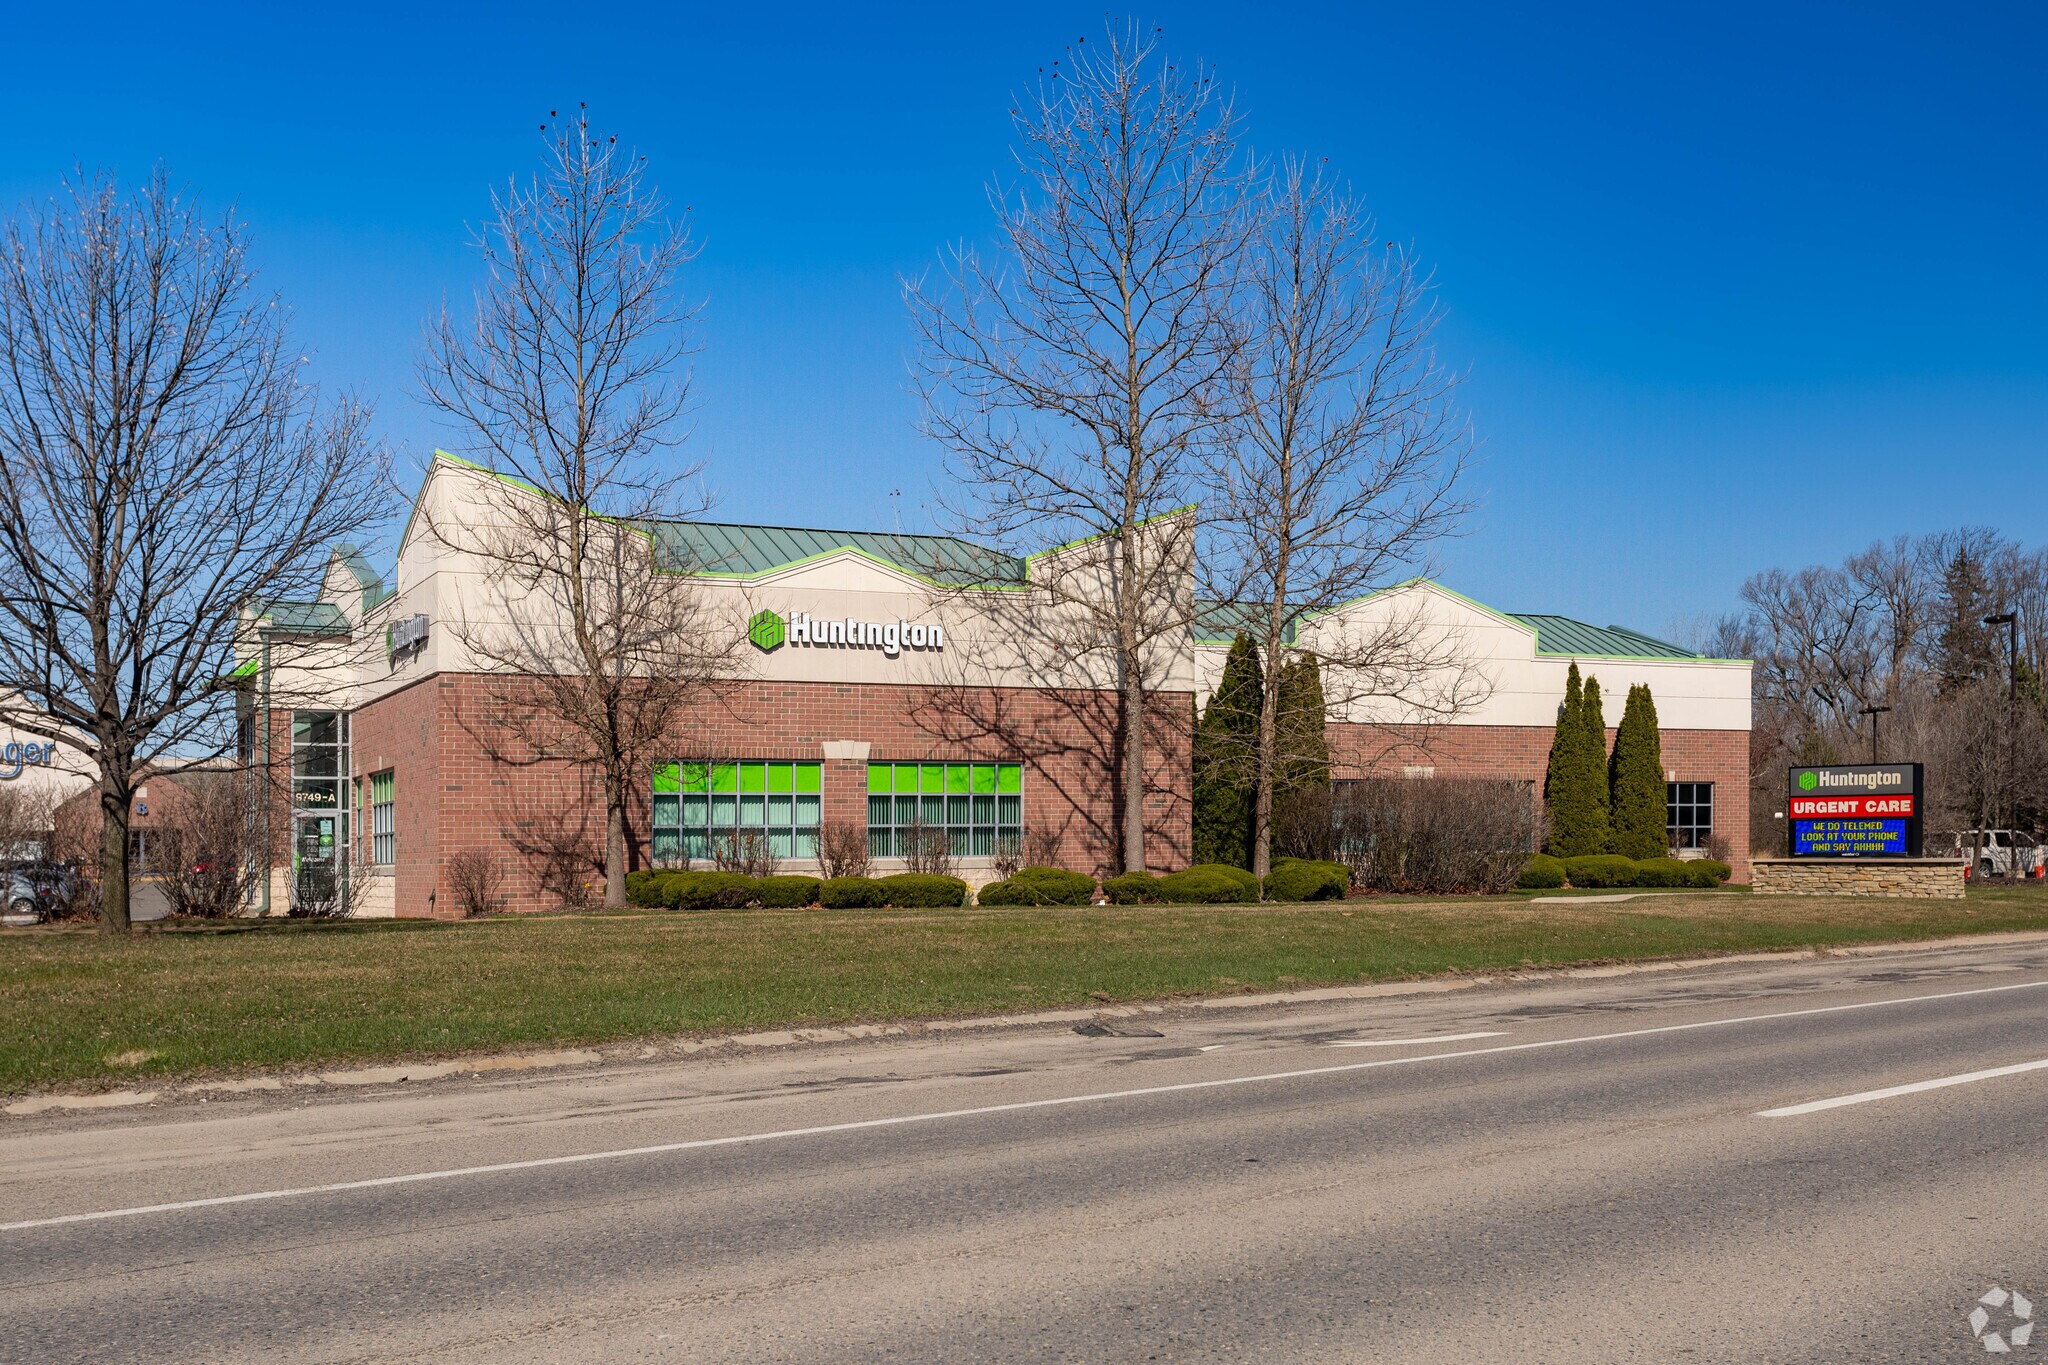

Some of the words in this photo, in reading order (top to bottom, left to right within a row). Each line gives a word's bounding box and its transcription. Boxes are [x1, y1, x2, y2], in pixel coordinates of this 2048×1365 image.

[789, 611, 943, 655] Huntington
[0, 741, 54, 778] ger
[1819, 771, 1901, 790] Huntington
[295, 792, 335, 802] 9749-A
[1794, 801, 1858, 814] URGENT
[1865, 800, 1911, 812] CARE
[1813, 822, 1825, 831] WE
[1828, 822, 1840, 830] DO
[1843, 822, 1883, 830] TELEMED
[1801, 833, 1824, 841] LOOK
[1827, 833, 1839, 841] AT
[1842, 832, 1866, 840] YOUR
[1868, 832, 1898, 840] PHONE
[1812, 843, 1830, 851] AND
[1833, 843, 1851, 851] SAY
[1854, 843, 1884, 851] AHHHH
